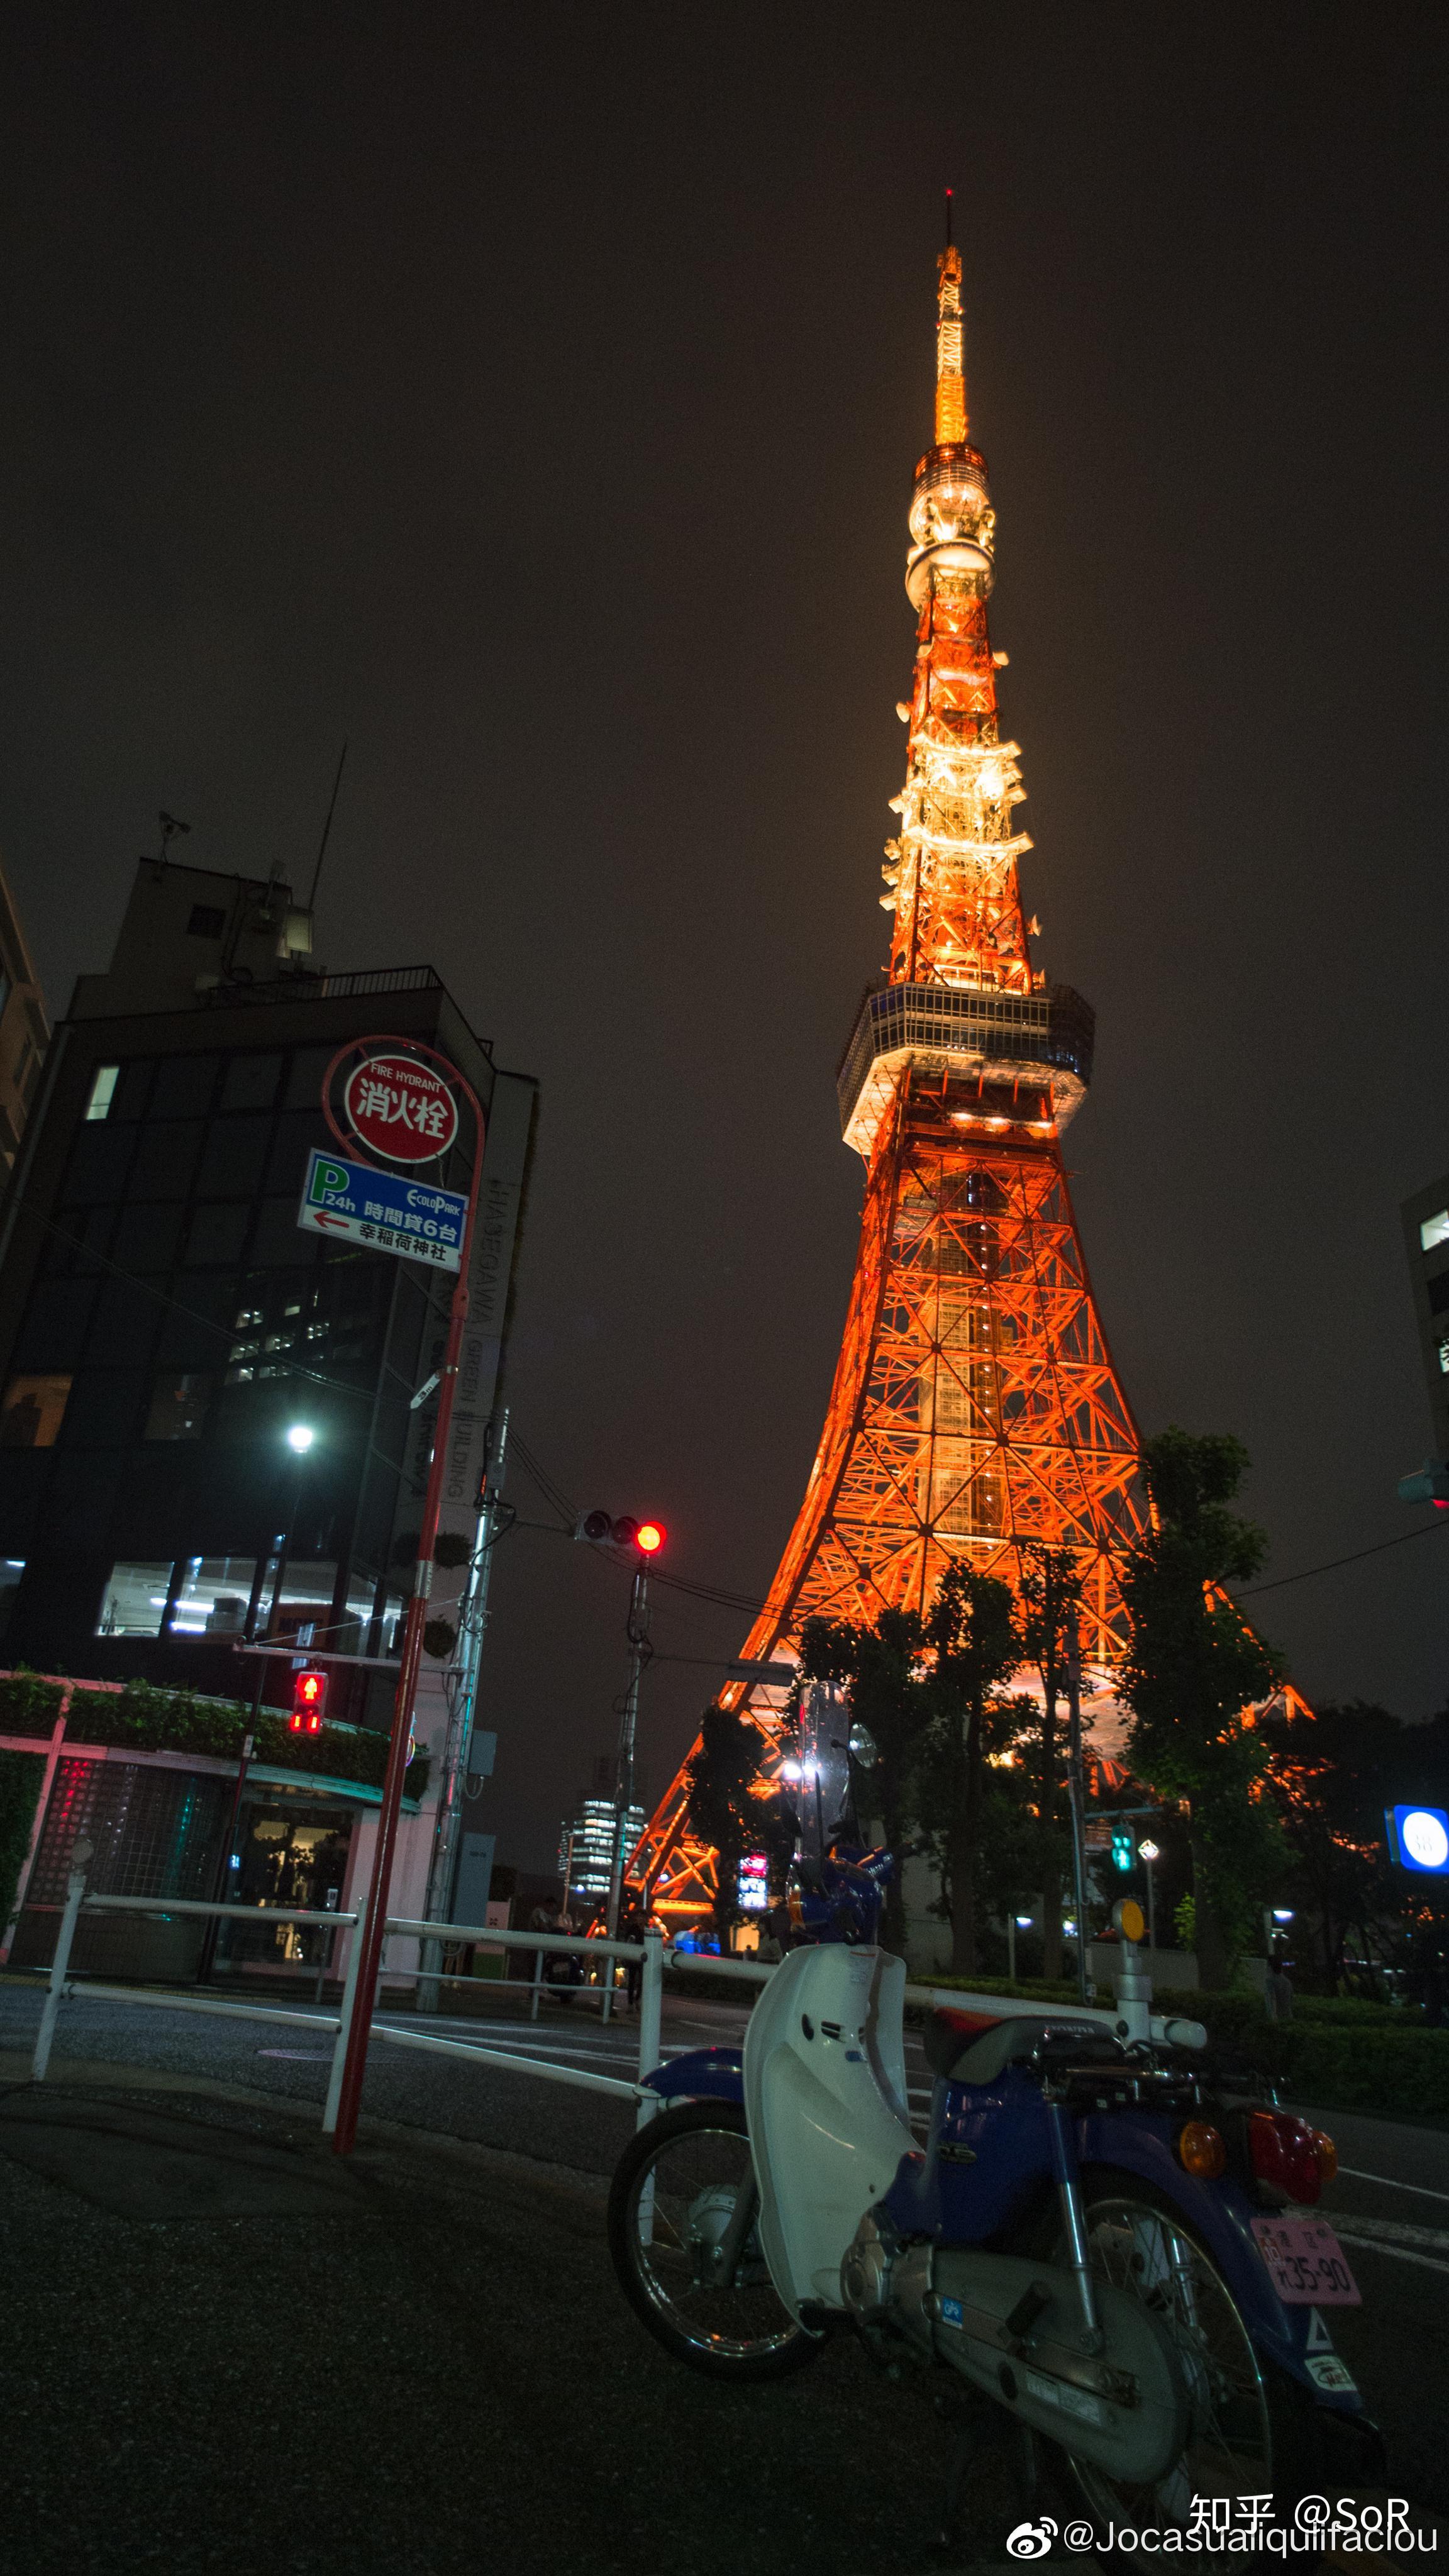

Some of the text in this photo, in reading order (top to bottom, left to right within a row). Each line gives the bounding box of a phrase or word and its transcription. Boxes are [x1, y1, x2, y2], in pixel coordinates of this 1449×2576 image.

[371, 1063, 441, 1093] FIRE HYDRANT
[356, 1077, 448, 1140] 消火栓
[309, 1158, 350, 1204] P
[325, 1193, 458, 1243] 24h 時間貸6台
[360, 1223, 446, 1261] 幸稲荷神社
